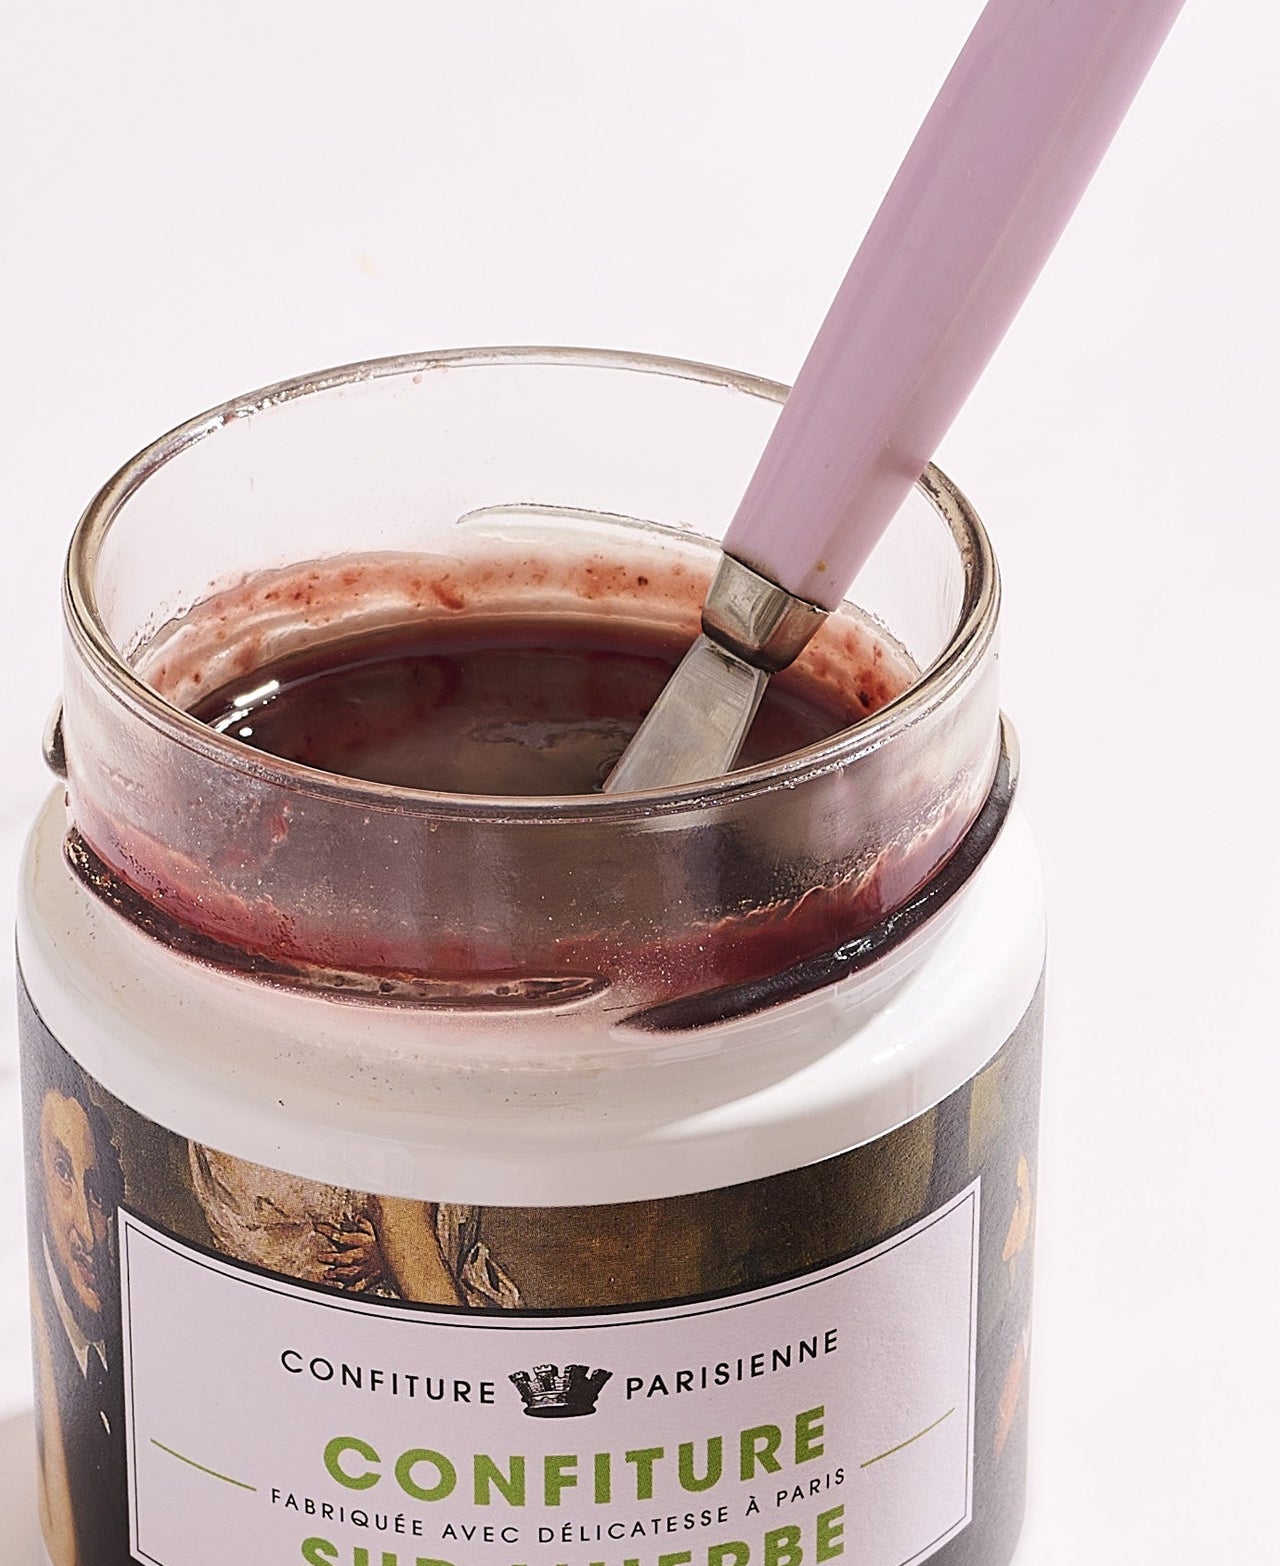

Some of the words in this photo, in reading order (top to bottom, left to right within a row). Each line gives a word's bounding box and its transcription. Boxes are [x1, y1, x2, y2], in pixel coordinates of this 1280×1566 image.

[280, 1349, 495, 1405] CONFITURE
[626, 1328, 838, 1401] PARISIENNE
[324, 1406, 825, 1507] CONFITURE
[271, 1487, 423, 1537] FABRIQUÉE
[441, 1523, 519, 1544] AVEC
[538, 1505, 729, 1544] DÉLICATESSE
[745, 1495, 761, 1517] À
[776, 1467, 845, 1508] PARIS
